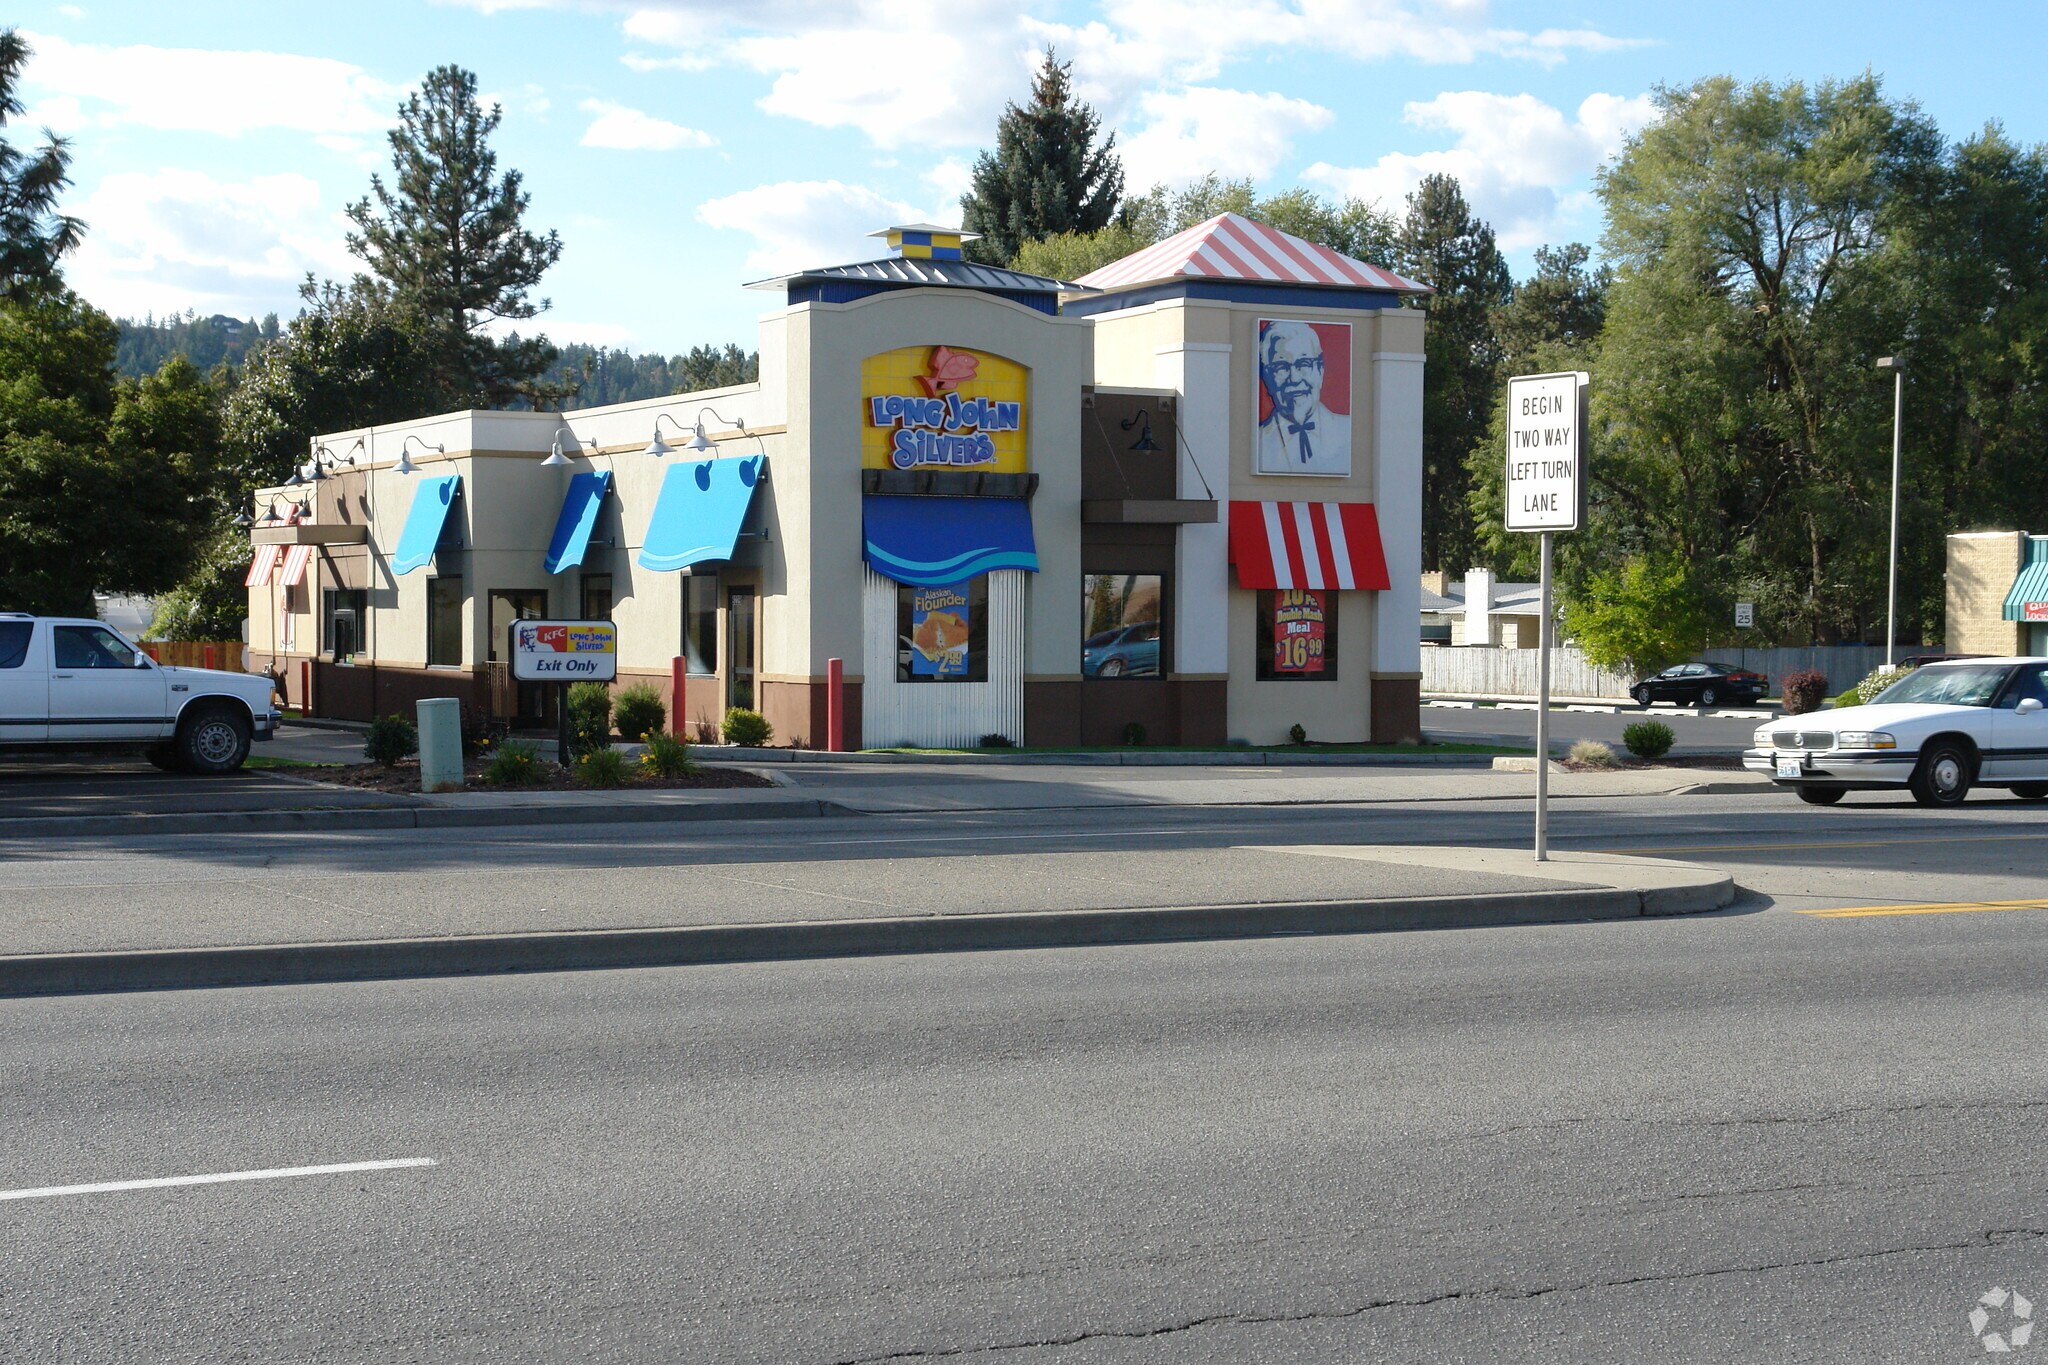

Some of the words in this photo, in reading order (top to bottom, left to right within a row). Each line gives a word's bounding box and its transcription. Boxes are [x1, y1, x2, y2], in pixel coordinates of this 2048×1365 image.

[1522, 395, 1563, 416] BEGIN
[1514, 429, 1540, 449] TWO
[1544, 427, 1570, 447] WAY
[1510, 462, 1539, 481] LEFT
[1541, 460, 1572, 479] TURN
[1524, 493, 1558, 513] LANE
[915, 593, 967, 612] Flounder
[925, 588, 952, 600] Alaskan
[1287, 621, 1311, 634] Meal
[1737, 614, 1751, 624] 25
[543, 628, 566, 641] KFC
[536, 659, 562, 671] Exit
[566, 659, 598, 674] Only
